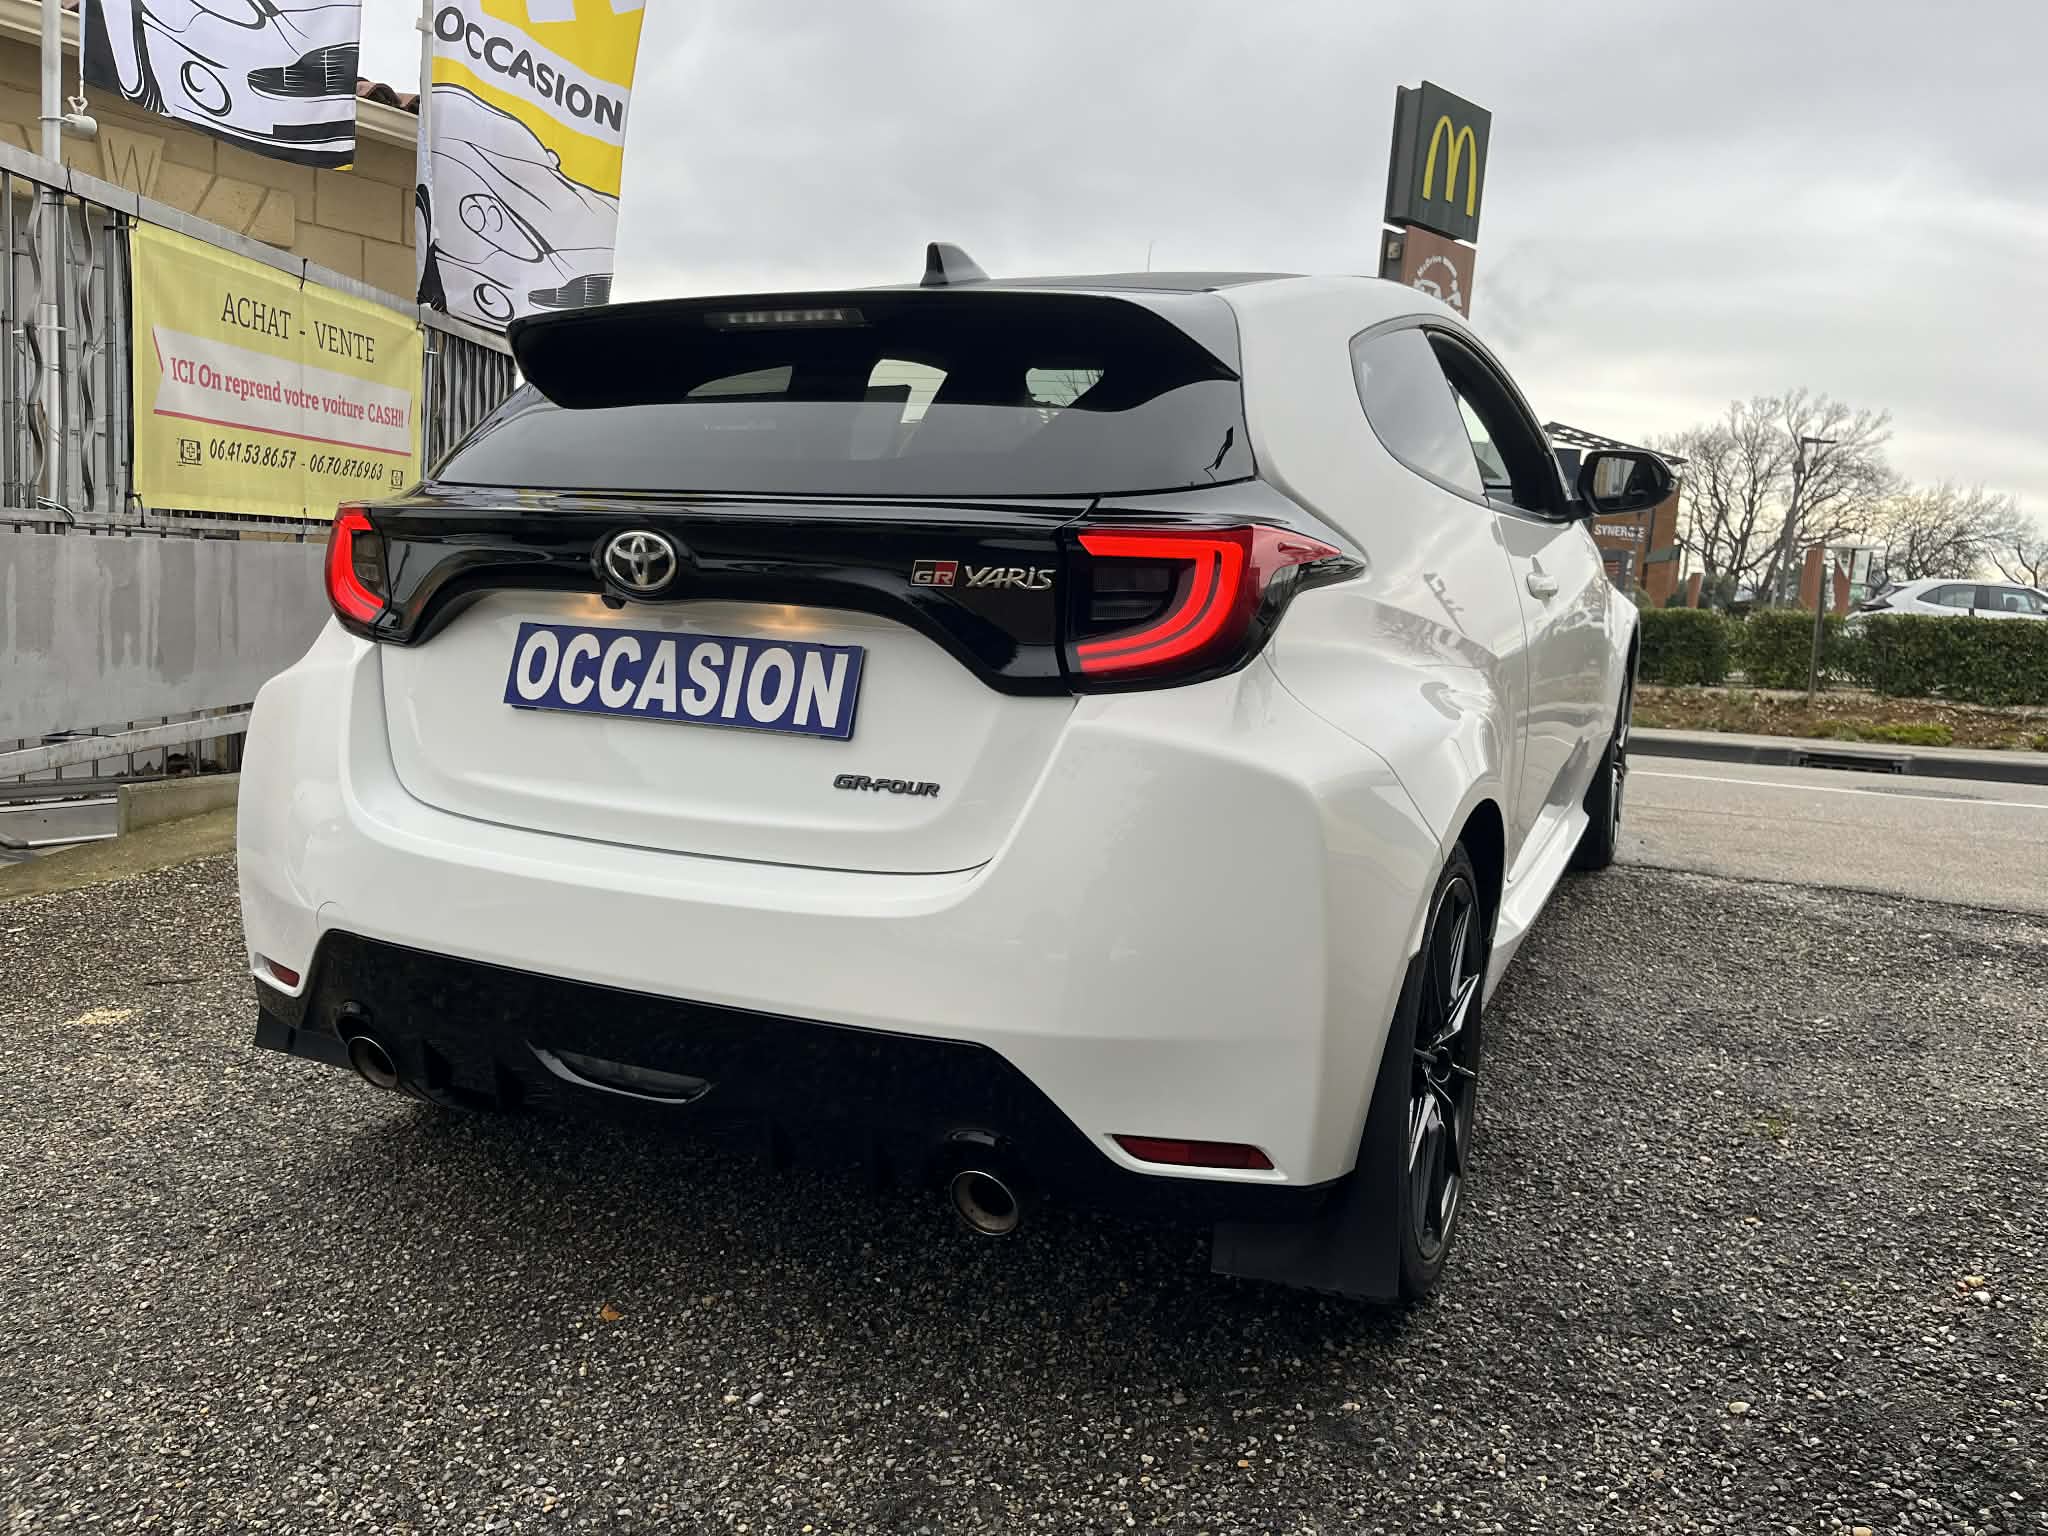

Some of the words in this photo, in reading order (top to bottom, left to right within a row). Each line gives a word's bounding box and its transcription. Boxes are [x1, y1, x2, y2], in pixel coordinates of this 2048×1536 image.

[435, 6, 623, 132] OCCASION
[221, 292, 291, 339] ACHAT
[314, 321, 375, 363] VENTE
[170, 357, 196, 385] ICI
[199, 364, 222, 391] On
[224, 376, 281, 403] reprend
[284, 388, 319, 411] votre
[322, 394, 365, 420] voiture
[367, 402, 404, 429] CASH!!
[209, 438, 296, 470] 06.41.53.86.57
[1593, 523, 1645, 539] SYNERGE
[914, 570, 953, 584] GR
[514, 630, 849, 729] OCCASION
[833, 774, 941, 797] GR-FOUR
